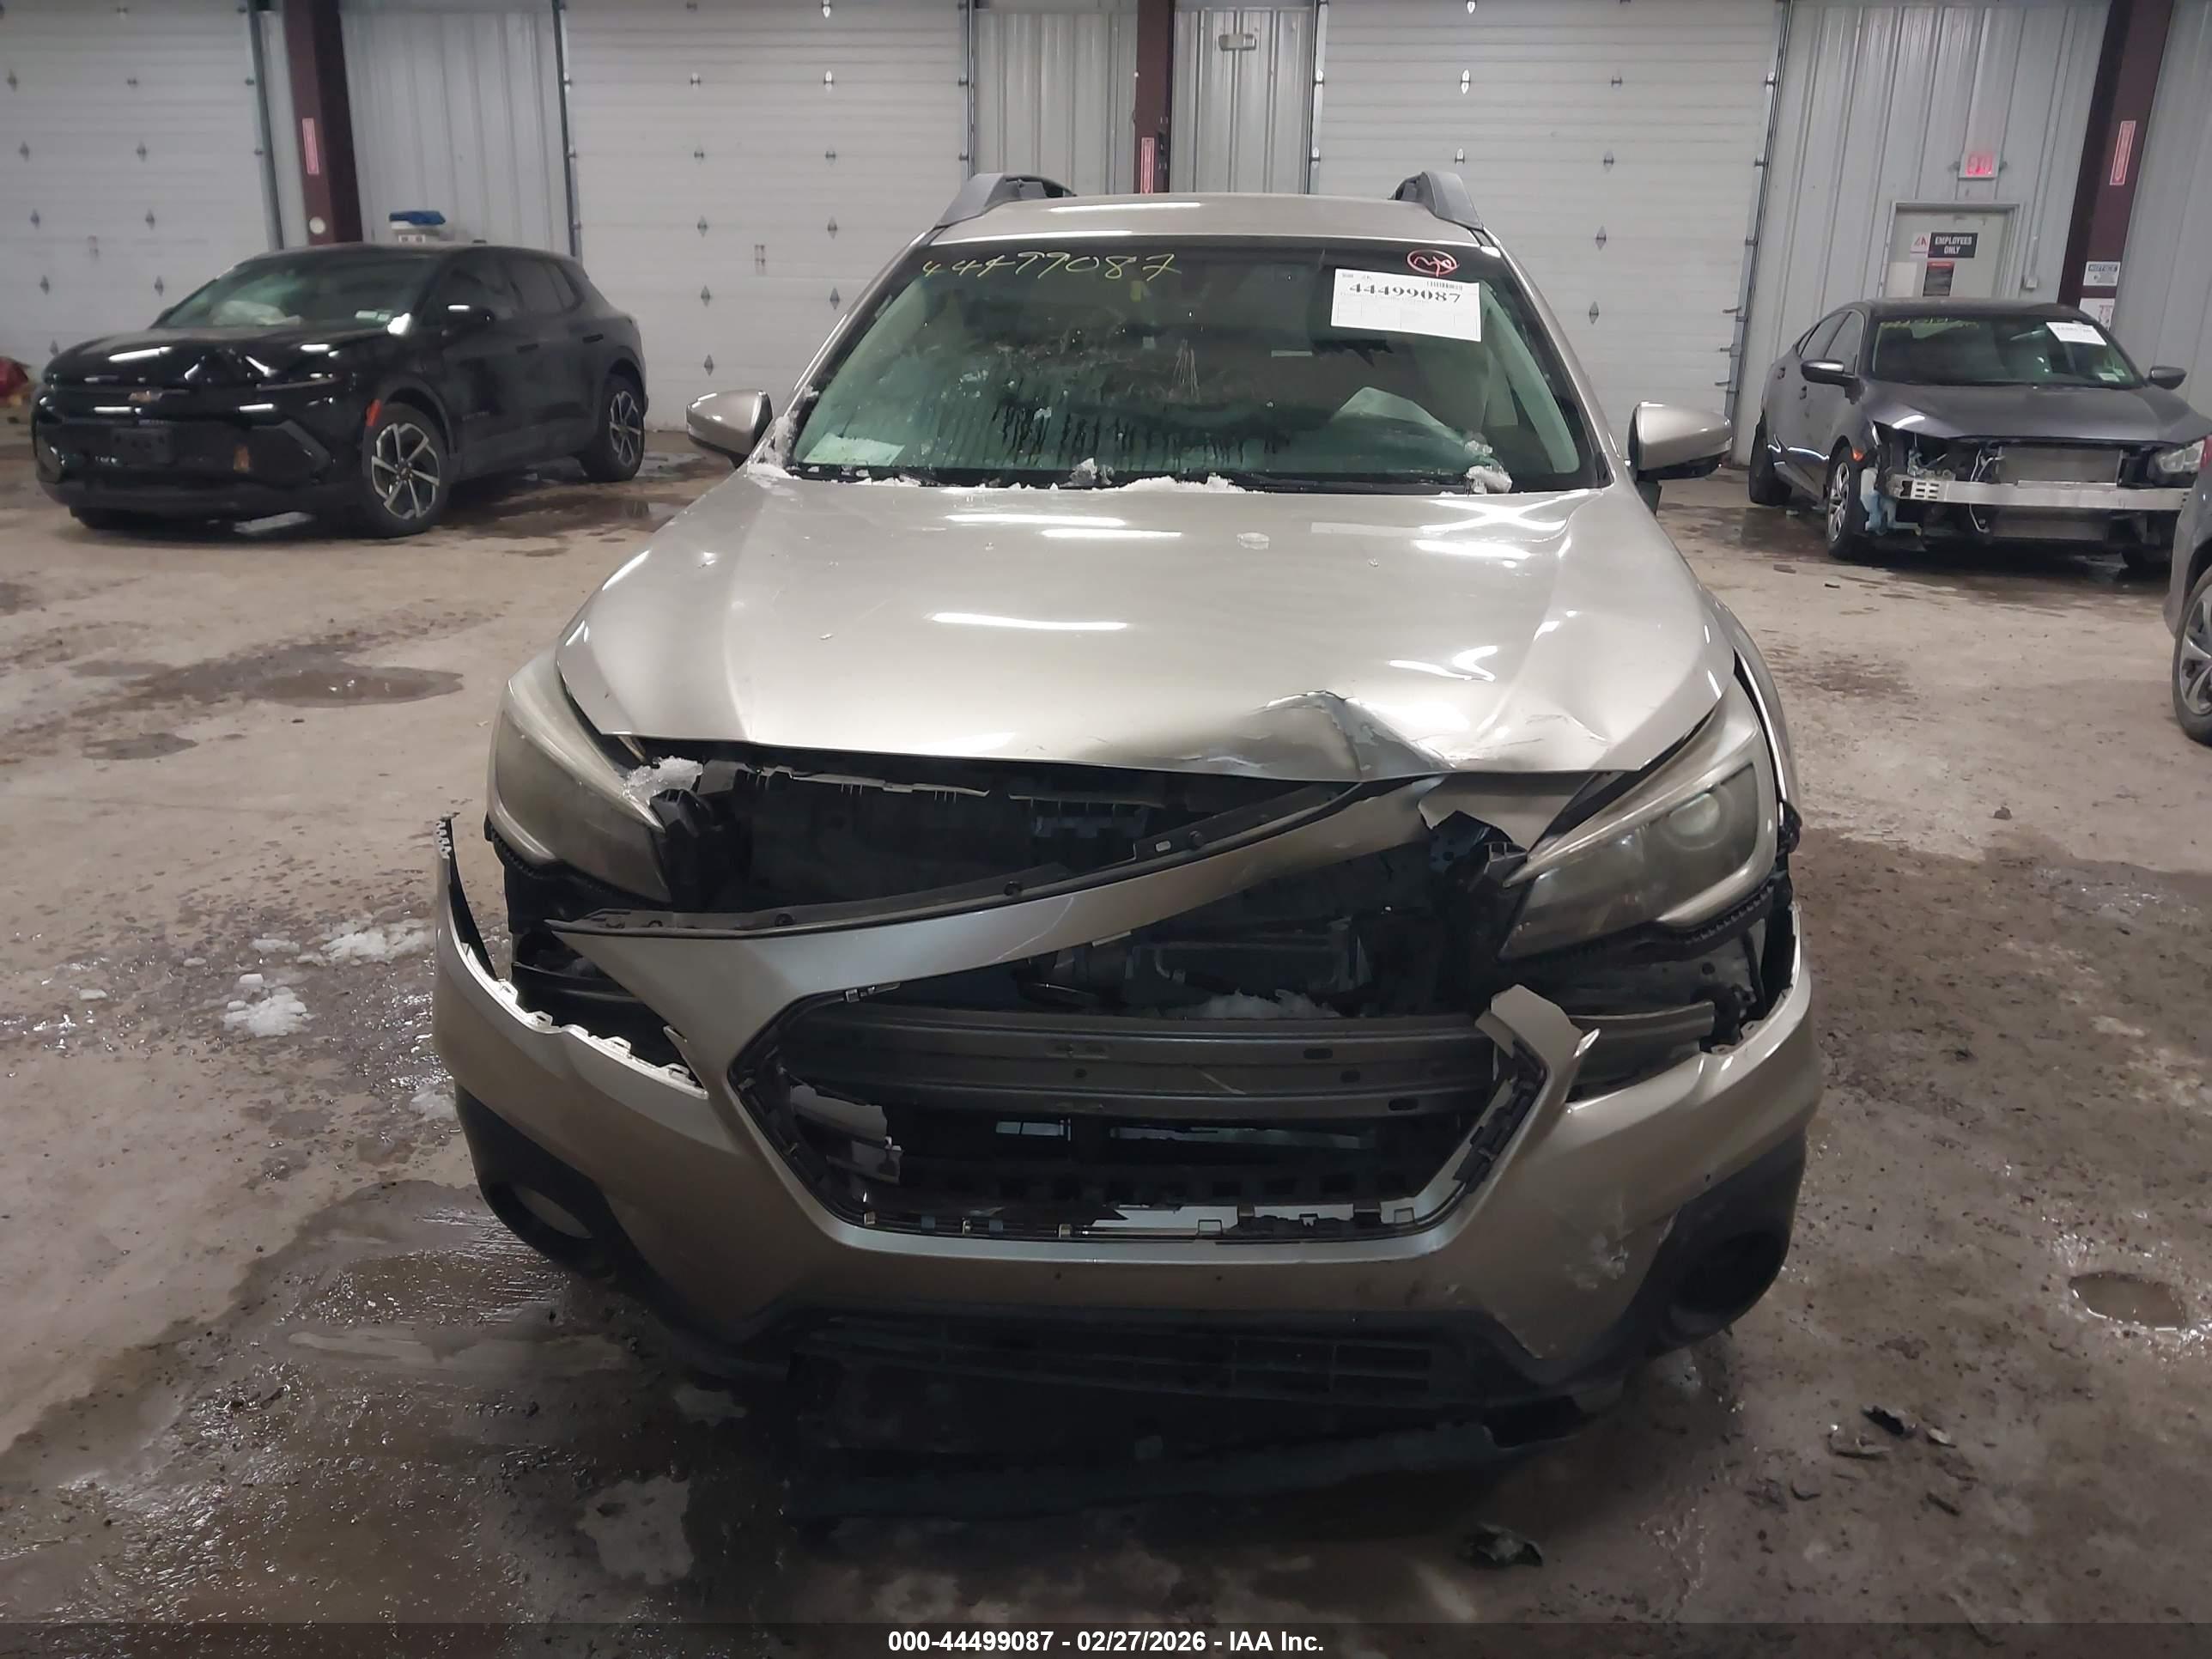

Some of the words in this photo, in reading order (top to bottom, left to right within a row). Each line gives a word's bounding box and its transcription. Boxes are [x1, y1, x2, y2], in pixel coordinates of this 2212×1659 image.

[1935, 236, 1972, 246] EMPLOYEES
[1943, 246, 1961, 255] ONLY
[1349, 283, 1462, 303] 44499087
